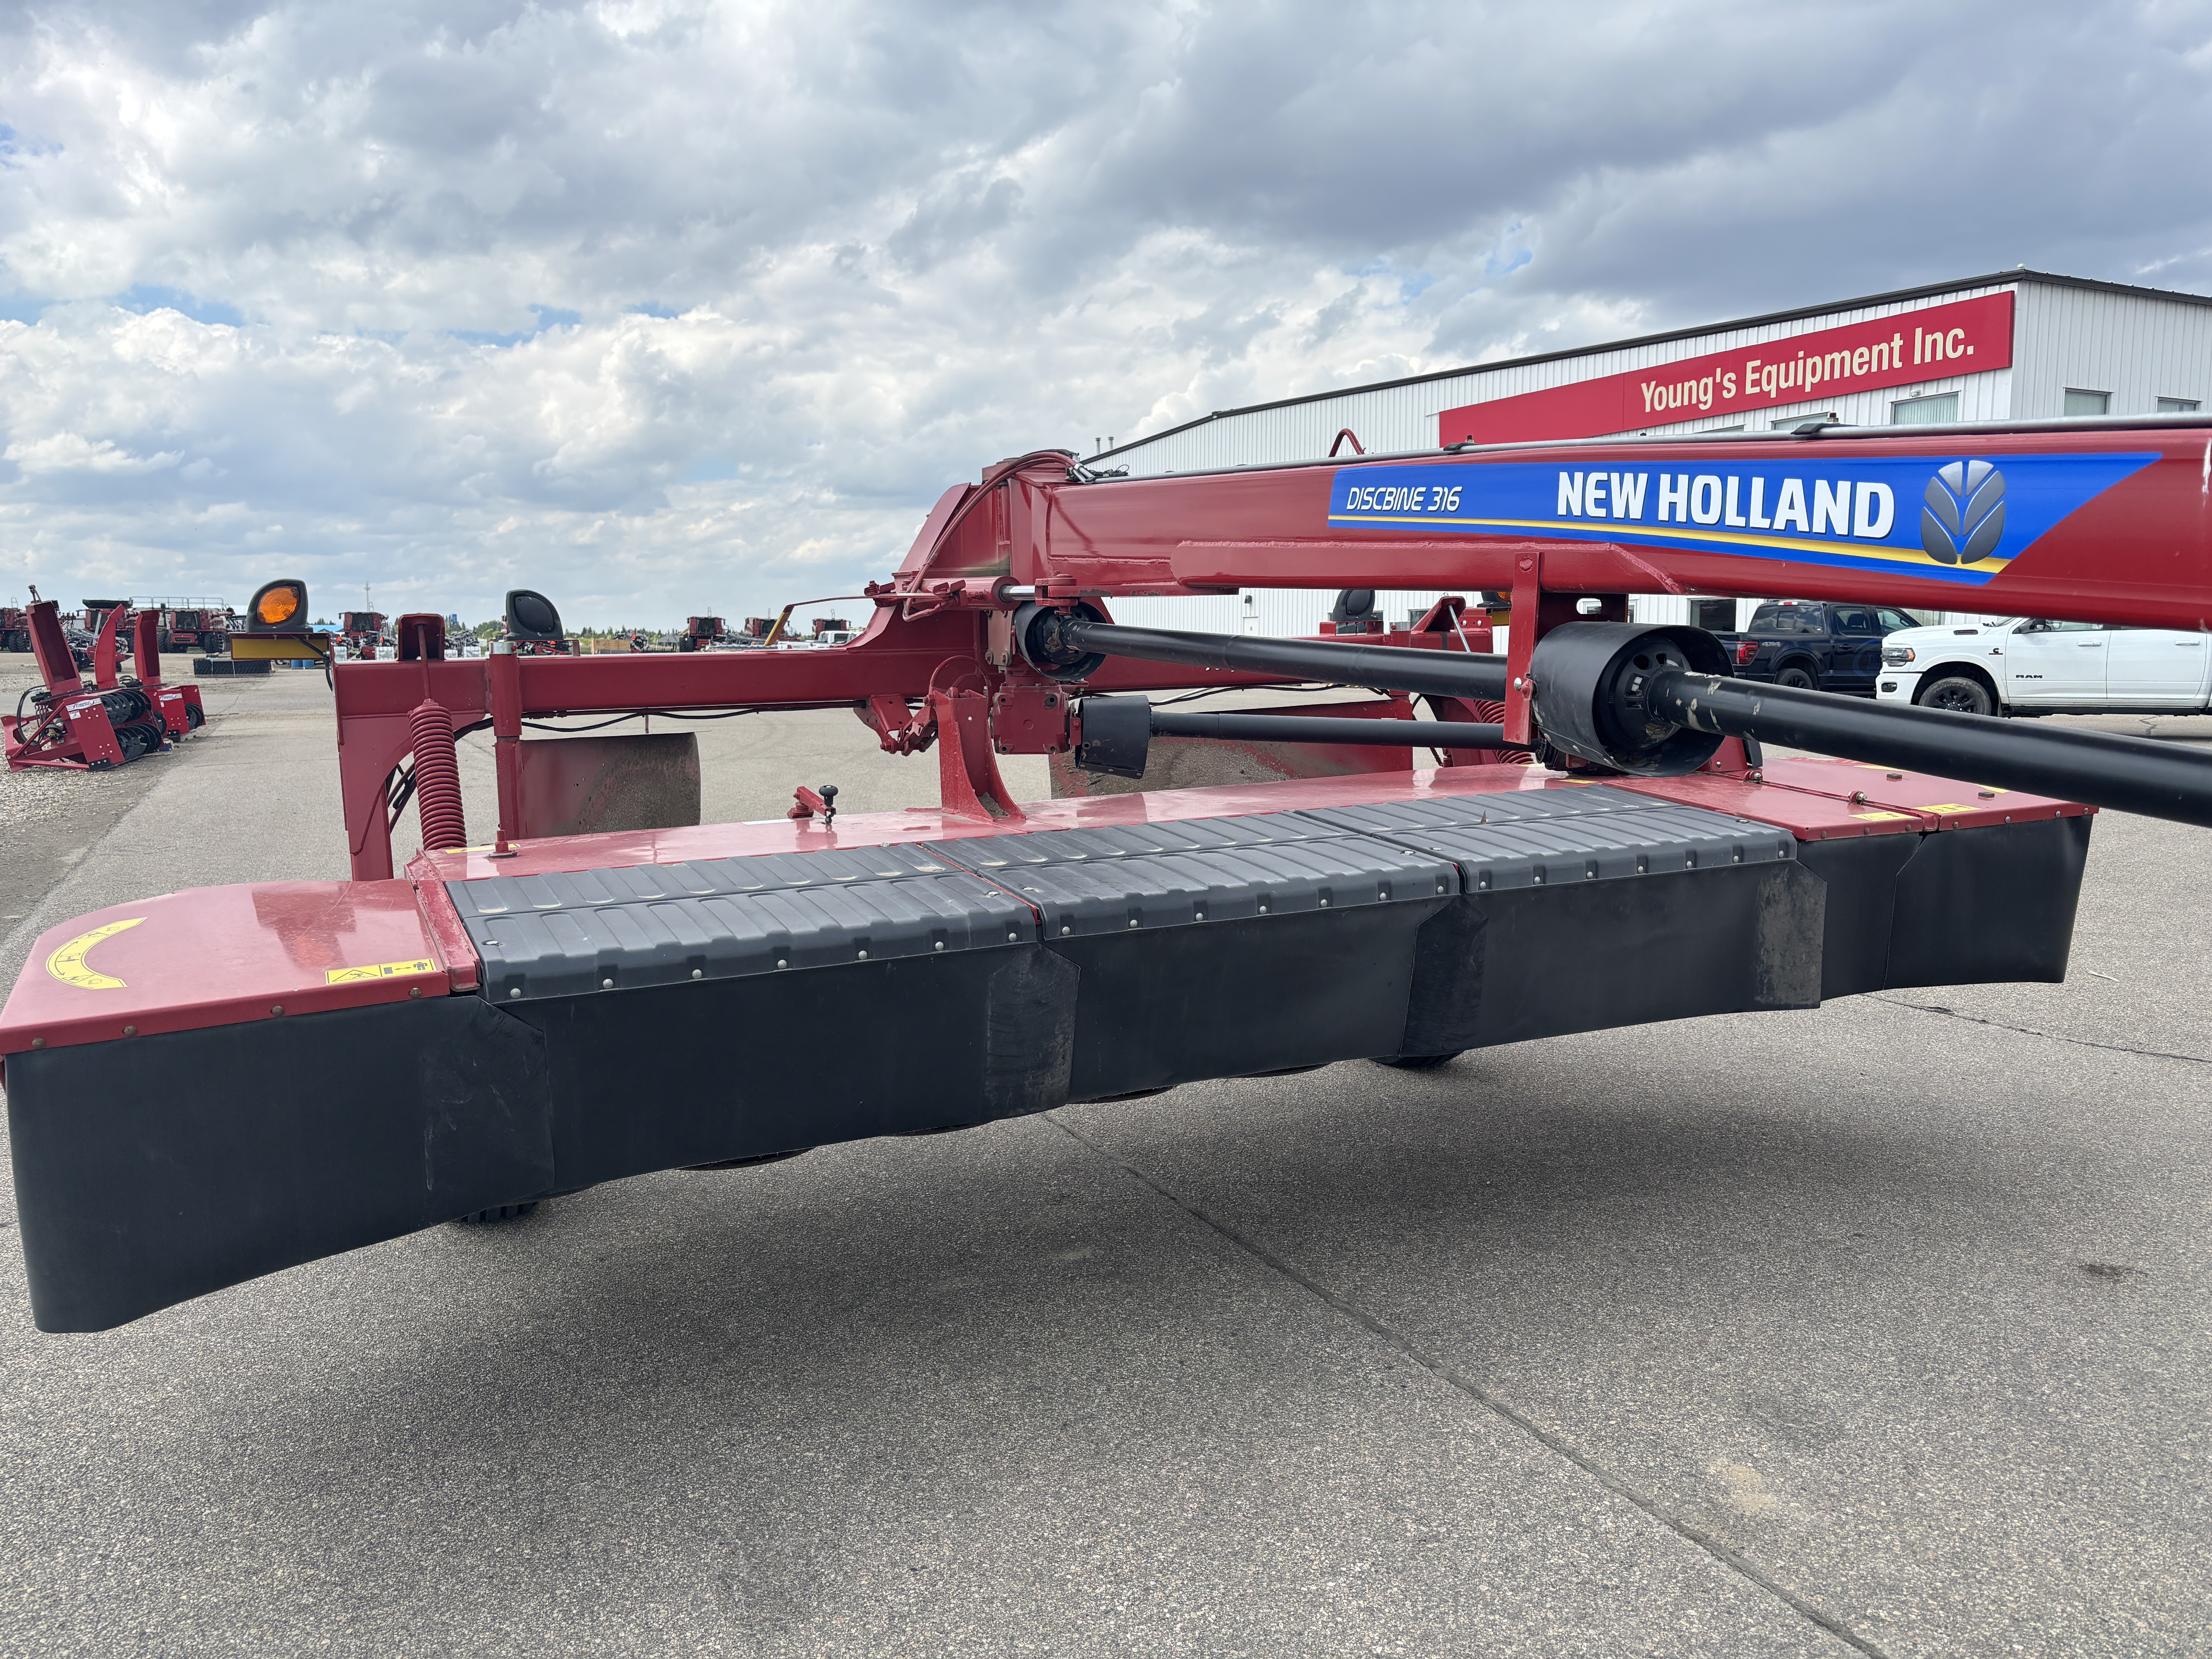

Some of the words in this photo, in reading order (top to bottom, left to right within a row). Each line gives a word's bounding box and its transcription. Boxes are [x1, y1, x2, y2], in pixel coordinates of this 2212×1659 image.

[1641, 368, 1736, 412] Young's
[1746, 333, 1903, 398] Equipment
[1914, 327, 1974, 365] Inc.
[1346, 487, 1426, 511] DISCBINE
[1427, 486, 1462, 511] 316
[1558, 472, 1647, 519] NEW
[1658, 474, 1894, 538] HOLLAND
